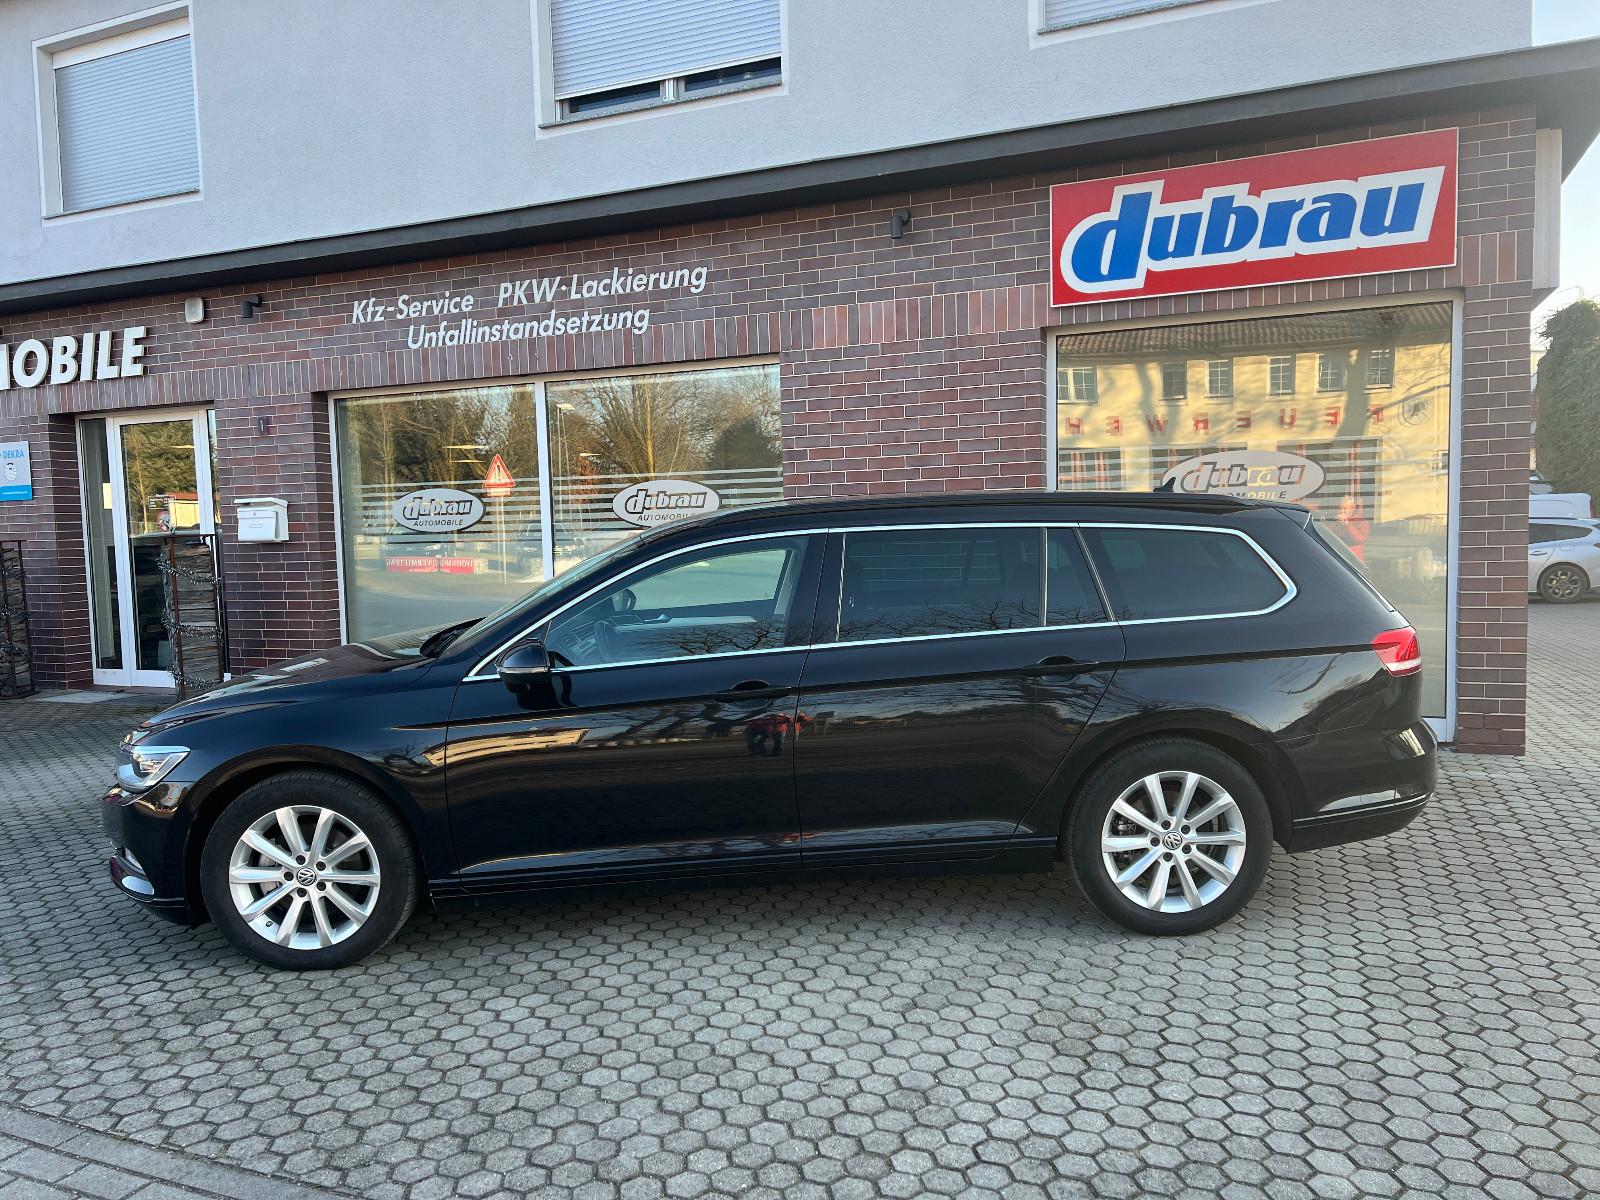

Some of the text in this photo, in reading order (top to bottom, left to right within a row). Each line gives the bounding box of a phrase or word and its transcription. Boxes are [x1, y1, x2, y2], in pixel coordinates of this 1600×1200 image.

[1063, 171, 1439, 291] dubrau
[352, 291, 474, 324] Kfz-Service
[407, 308, 650, 350] Unfallinstandsetzung
[3, 449, 25, 459] DEKRA
[1181, 461, 1305, 493] dubrau
[625, 489, 708, 514] dubrau
[1227, 490, 1288, 500] OMOBILE
[403, 497, 473, 520] dubrau
[637, 513, 690, 521] AUTOMOBIL
[413, 519, 464, 527] AUTOMOBILE
